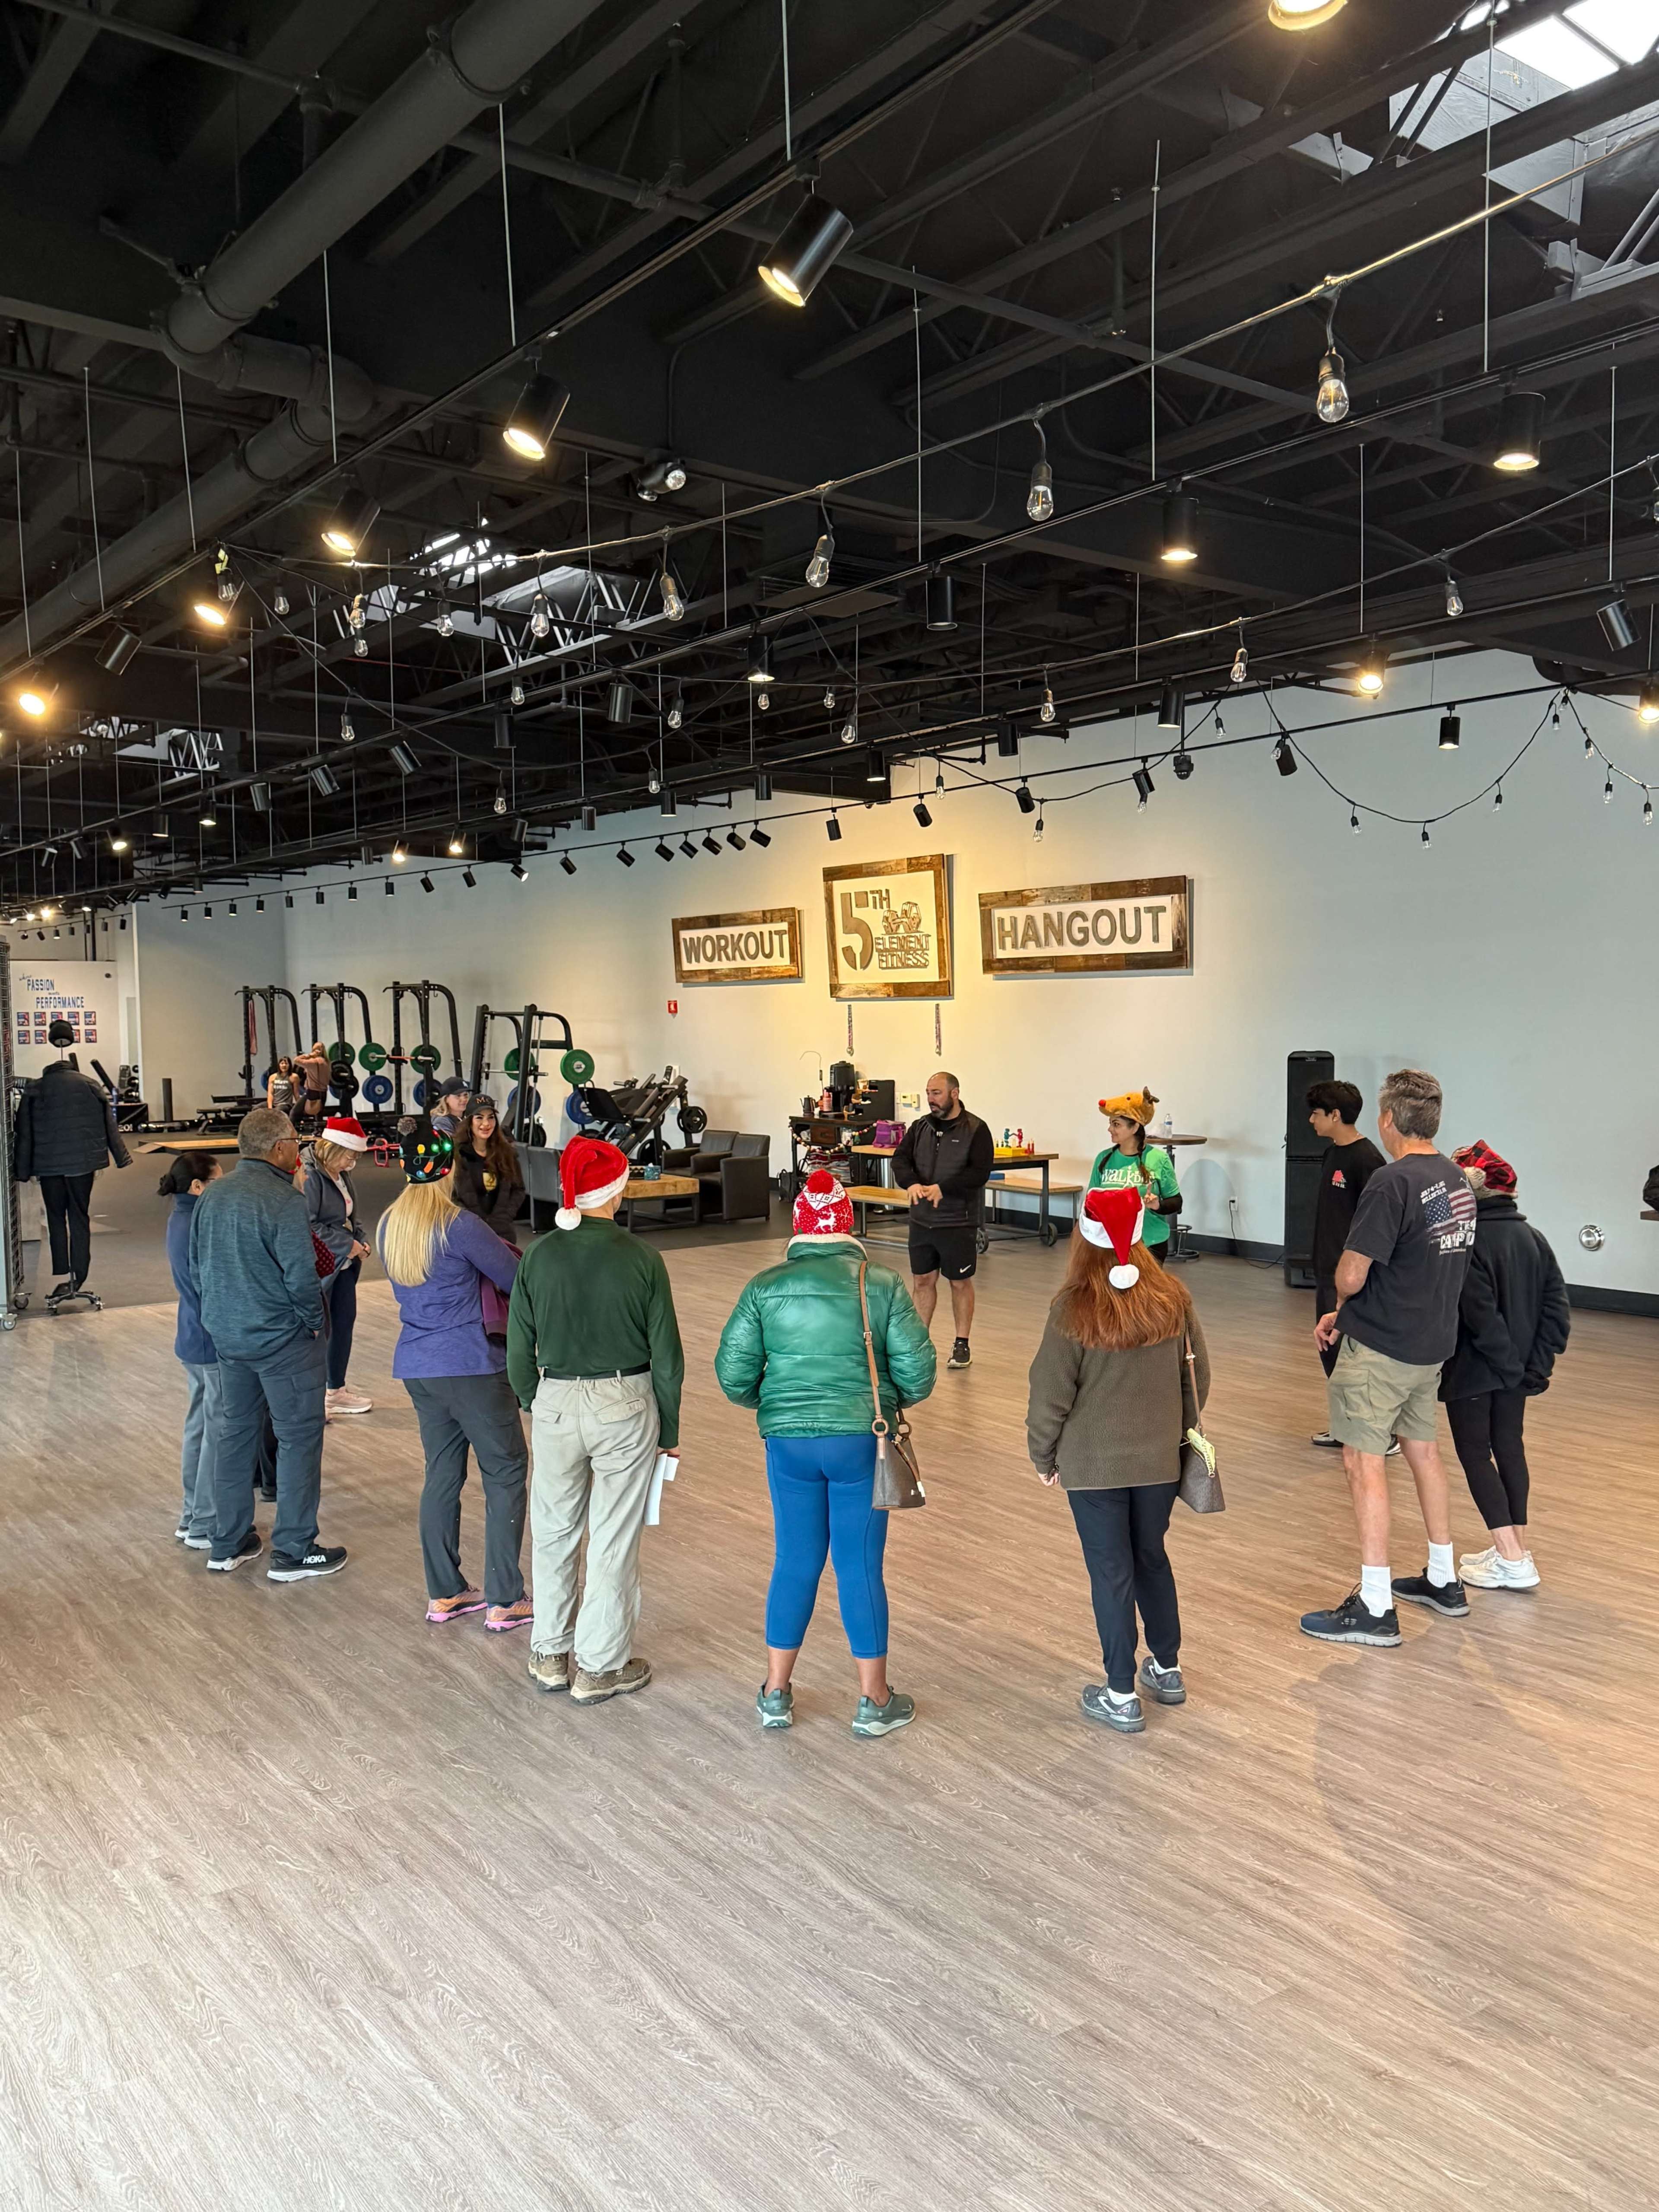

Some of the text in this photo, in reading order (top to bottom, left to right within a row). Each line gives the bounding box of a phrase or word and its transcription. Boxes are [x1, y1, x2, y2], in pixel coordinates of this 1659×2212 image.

[997, 906, 1166, 950] HANGOUT
[682, 929, 787, 964] WORKOUT
[874, 934, 931, 952] ELEMENT
[878, 950, 929, 969] FITNESS
[27, 979, 54, 991] PASSION
[36, 996, 85, 1009] PERFORMANCE
[302, 1555, 327, 1564] HOKA
